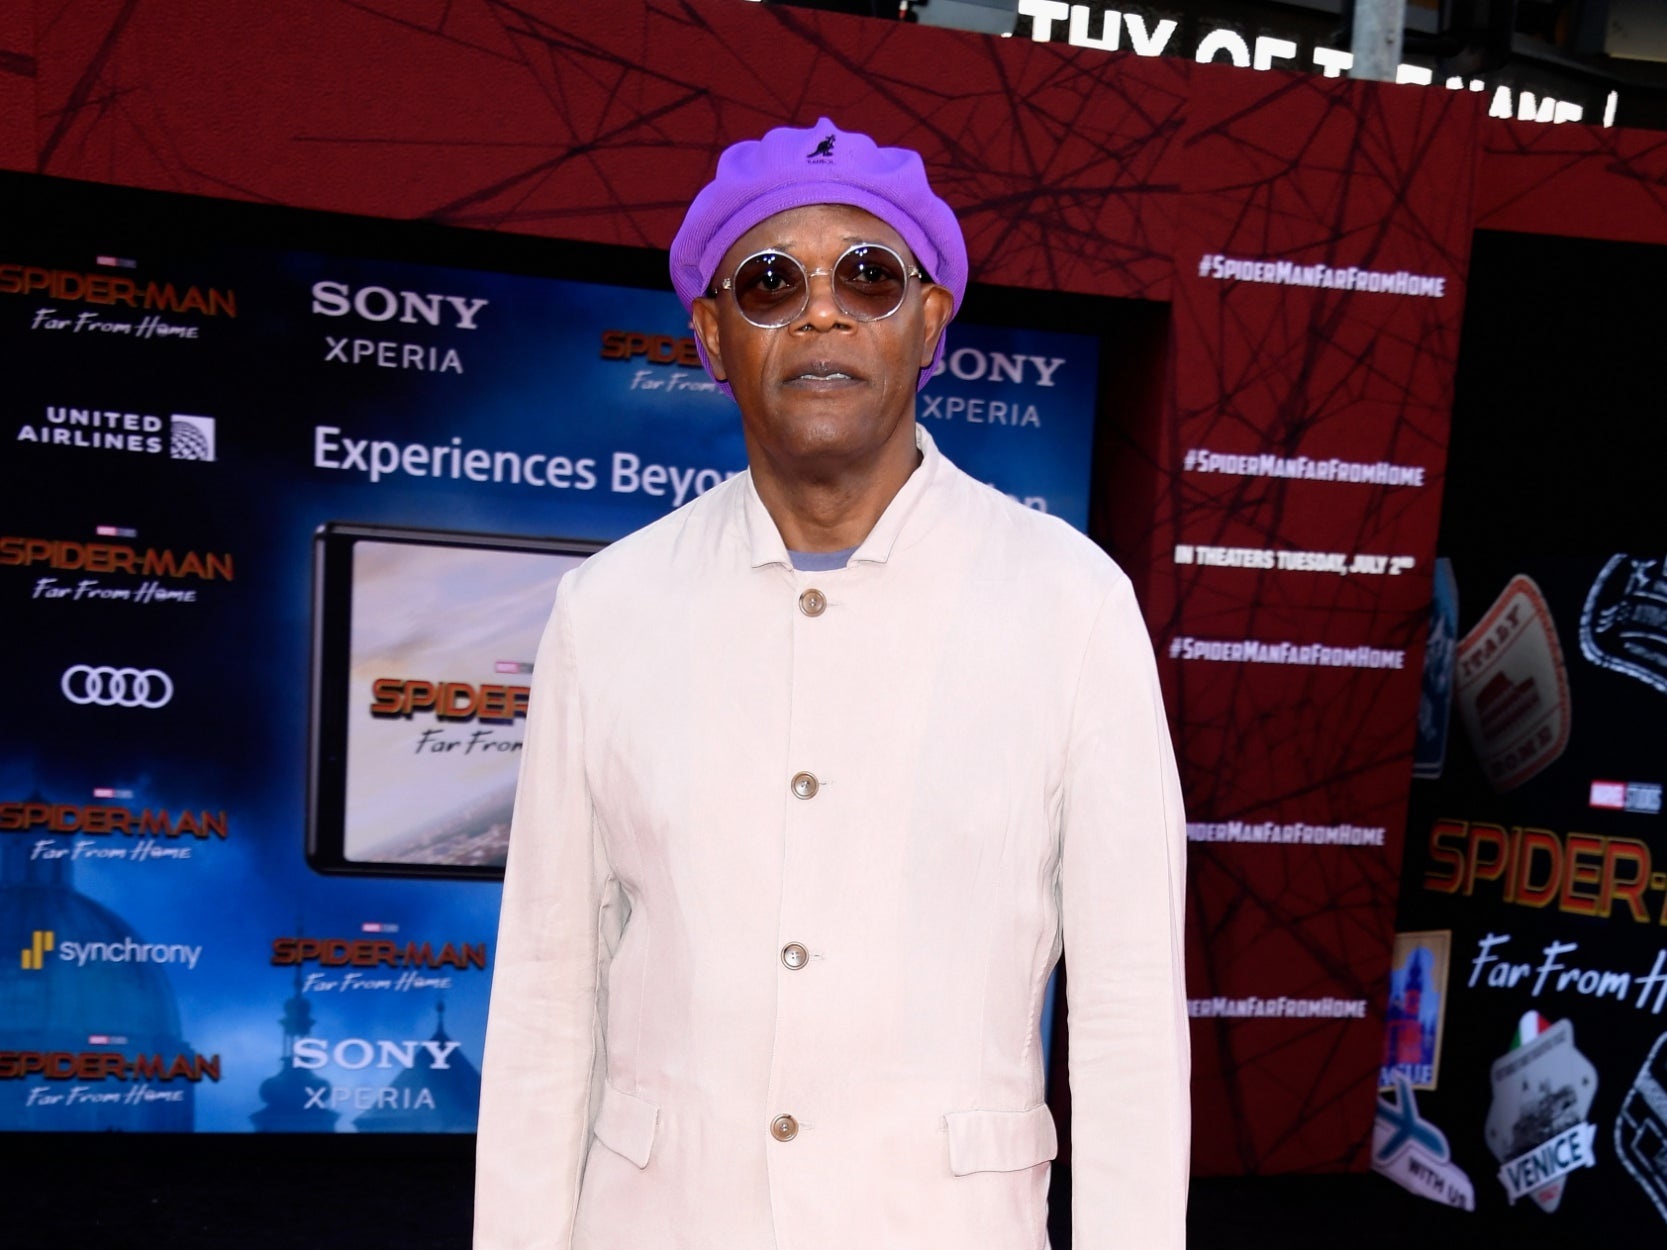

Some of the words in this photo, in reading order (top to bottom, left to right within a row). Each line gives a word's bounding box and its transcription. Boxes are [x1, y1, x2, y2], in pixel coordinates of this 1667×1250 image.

[0, 263, 238, 319] SPIDER-MAN
[311, 280, 489, 330] SONY
[31, 307, 71, 330] Far
[72, 312, 132, 334] From
[324, 336, 464, 374] XPERIA
[630, 370, 664, 391] Far
[46, 406, 163, 433] UNITED
[921, 394, 1042, 429] XPERIA
[16, 424, 163, 454] AIRLINES
[313, 425, 597, 491] Experiences
[0, 536, 235, 582] SPIDER-MAN
[1196, 546, 1275, 570] THEATERS
[1348, 554, 1389, 575] JULY
[32, 577, 72, 600] Far
[73, 579, 131, 601] From
[415, 729, 460, 754] Far
[0, 801, 229, 838] SPIDER-MAN
[30, 839, 70, 861] Far
[70, 840, 126, 861] From
[1424, 817, 1667, 927] SPIDER-
[59, 936, 202, 970] synchrony
[270, 937, 486, 969] SPIDER-MAN
[1467, 932, 1531, 988] Far
[1530, 939, 1631, 1001] From
[302, 972, 338, 992] Far
[338, 972, 391, 993] From
[0, 1051, 220, 1082] SPIDER-MAN
[292, 1038, 461, 1070] SONY
[25, 1086, 64, 1107] Far
[65, 1085, 121, 1107] From
[303, 1086, 436, 1110] XPERIA
[1408, 1155, 1445, 1194] WITH
[1507, 1131, 1582, 1192] VENICE
